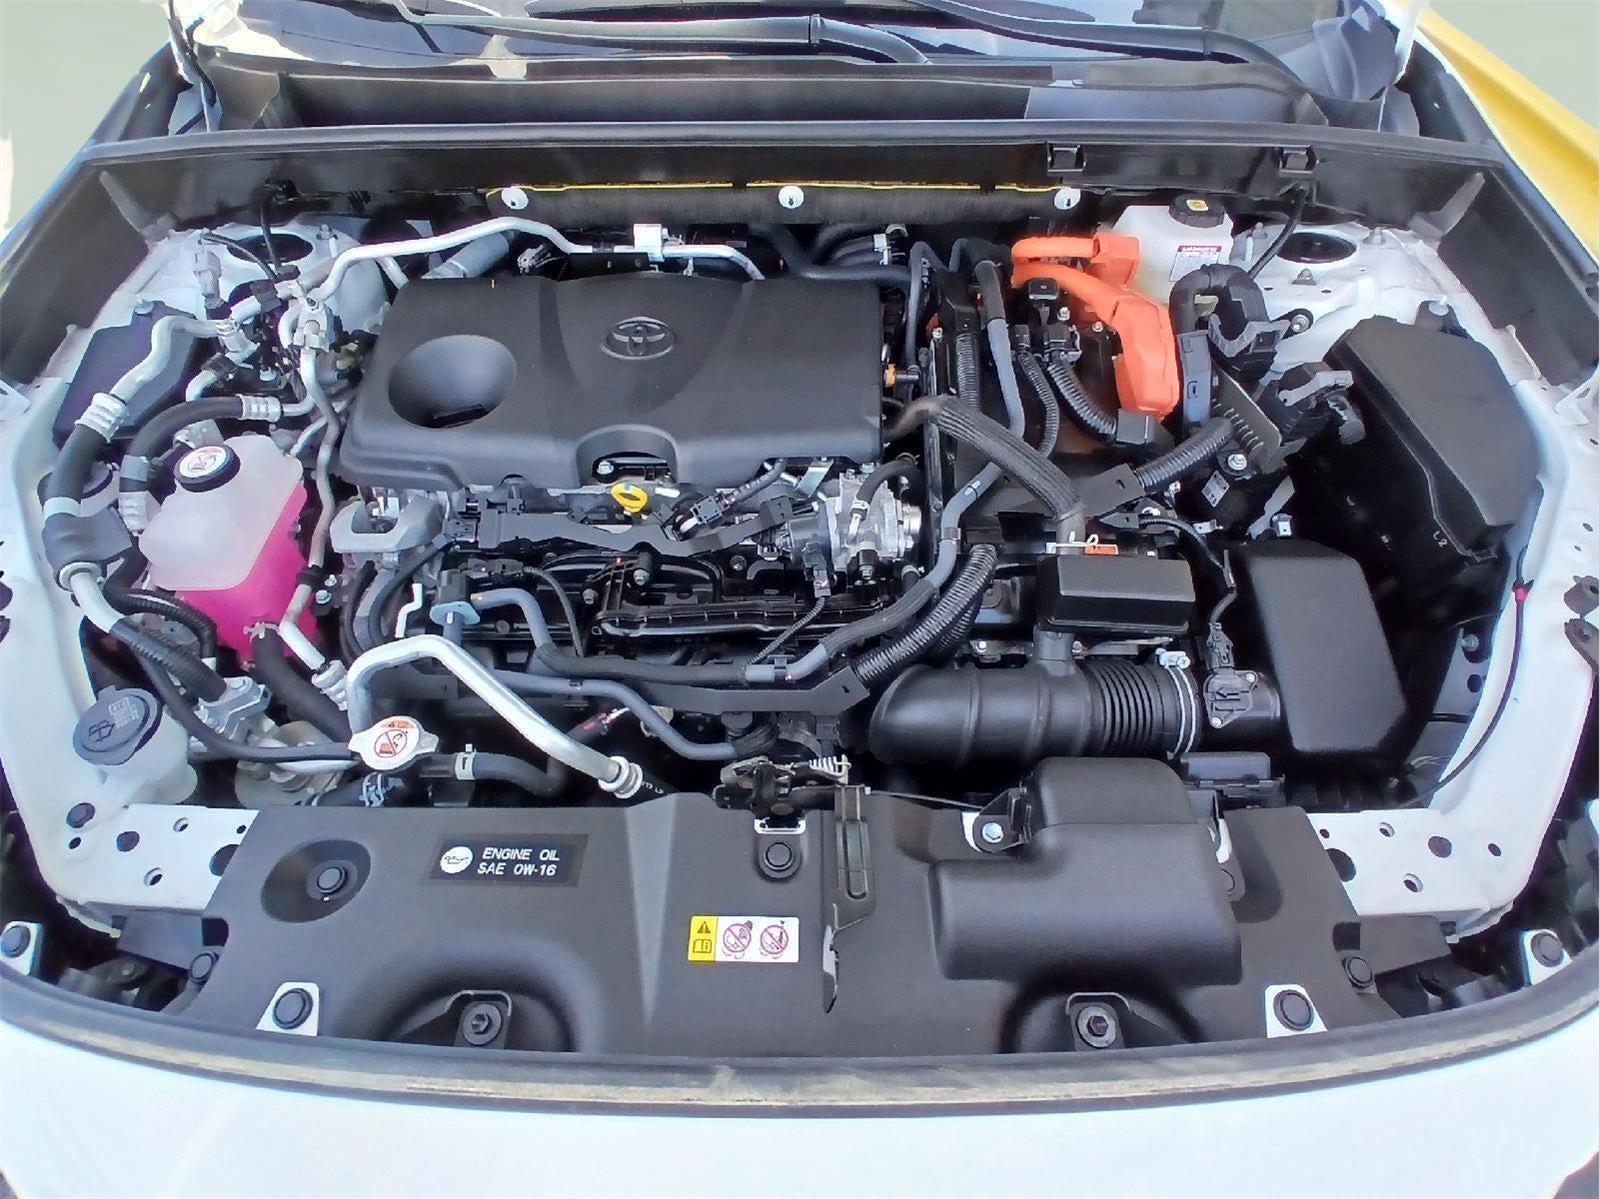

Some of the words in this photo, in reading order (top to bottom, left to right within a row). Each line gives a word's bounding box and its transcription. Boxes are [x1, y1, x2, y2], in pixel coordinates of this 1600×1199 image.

[482, 847, 532, 861] ENGINE
[539, 849, 561, 861] OIL
[477, 862, 507, 875] SAE
[513, 864, 558, 876] 0W-16
